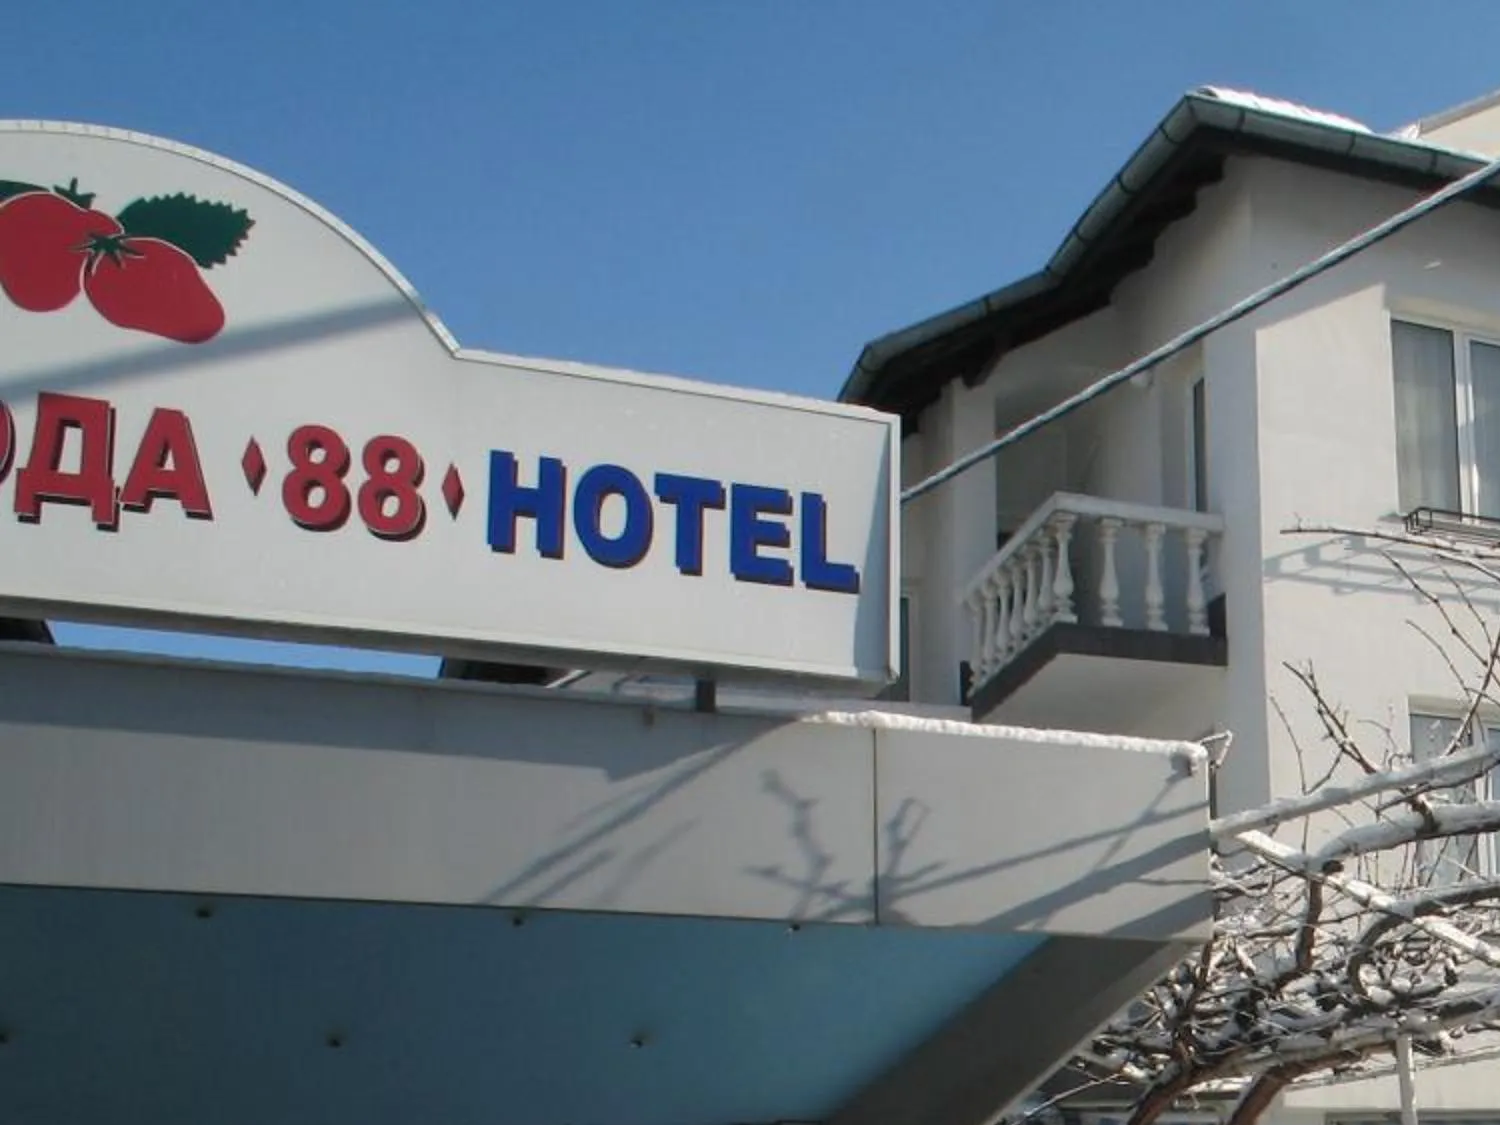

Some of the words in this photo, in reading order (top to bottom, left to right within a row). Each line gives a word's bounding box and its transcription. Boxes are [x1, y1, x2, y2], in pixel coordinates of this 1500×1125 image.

[0, 391, 213, 532] ДА
[282, 424, 425, 542] 88
[487, 450, 860, 593] HOTEL
